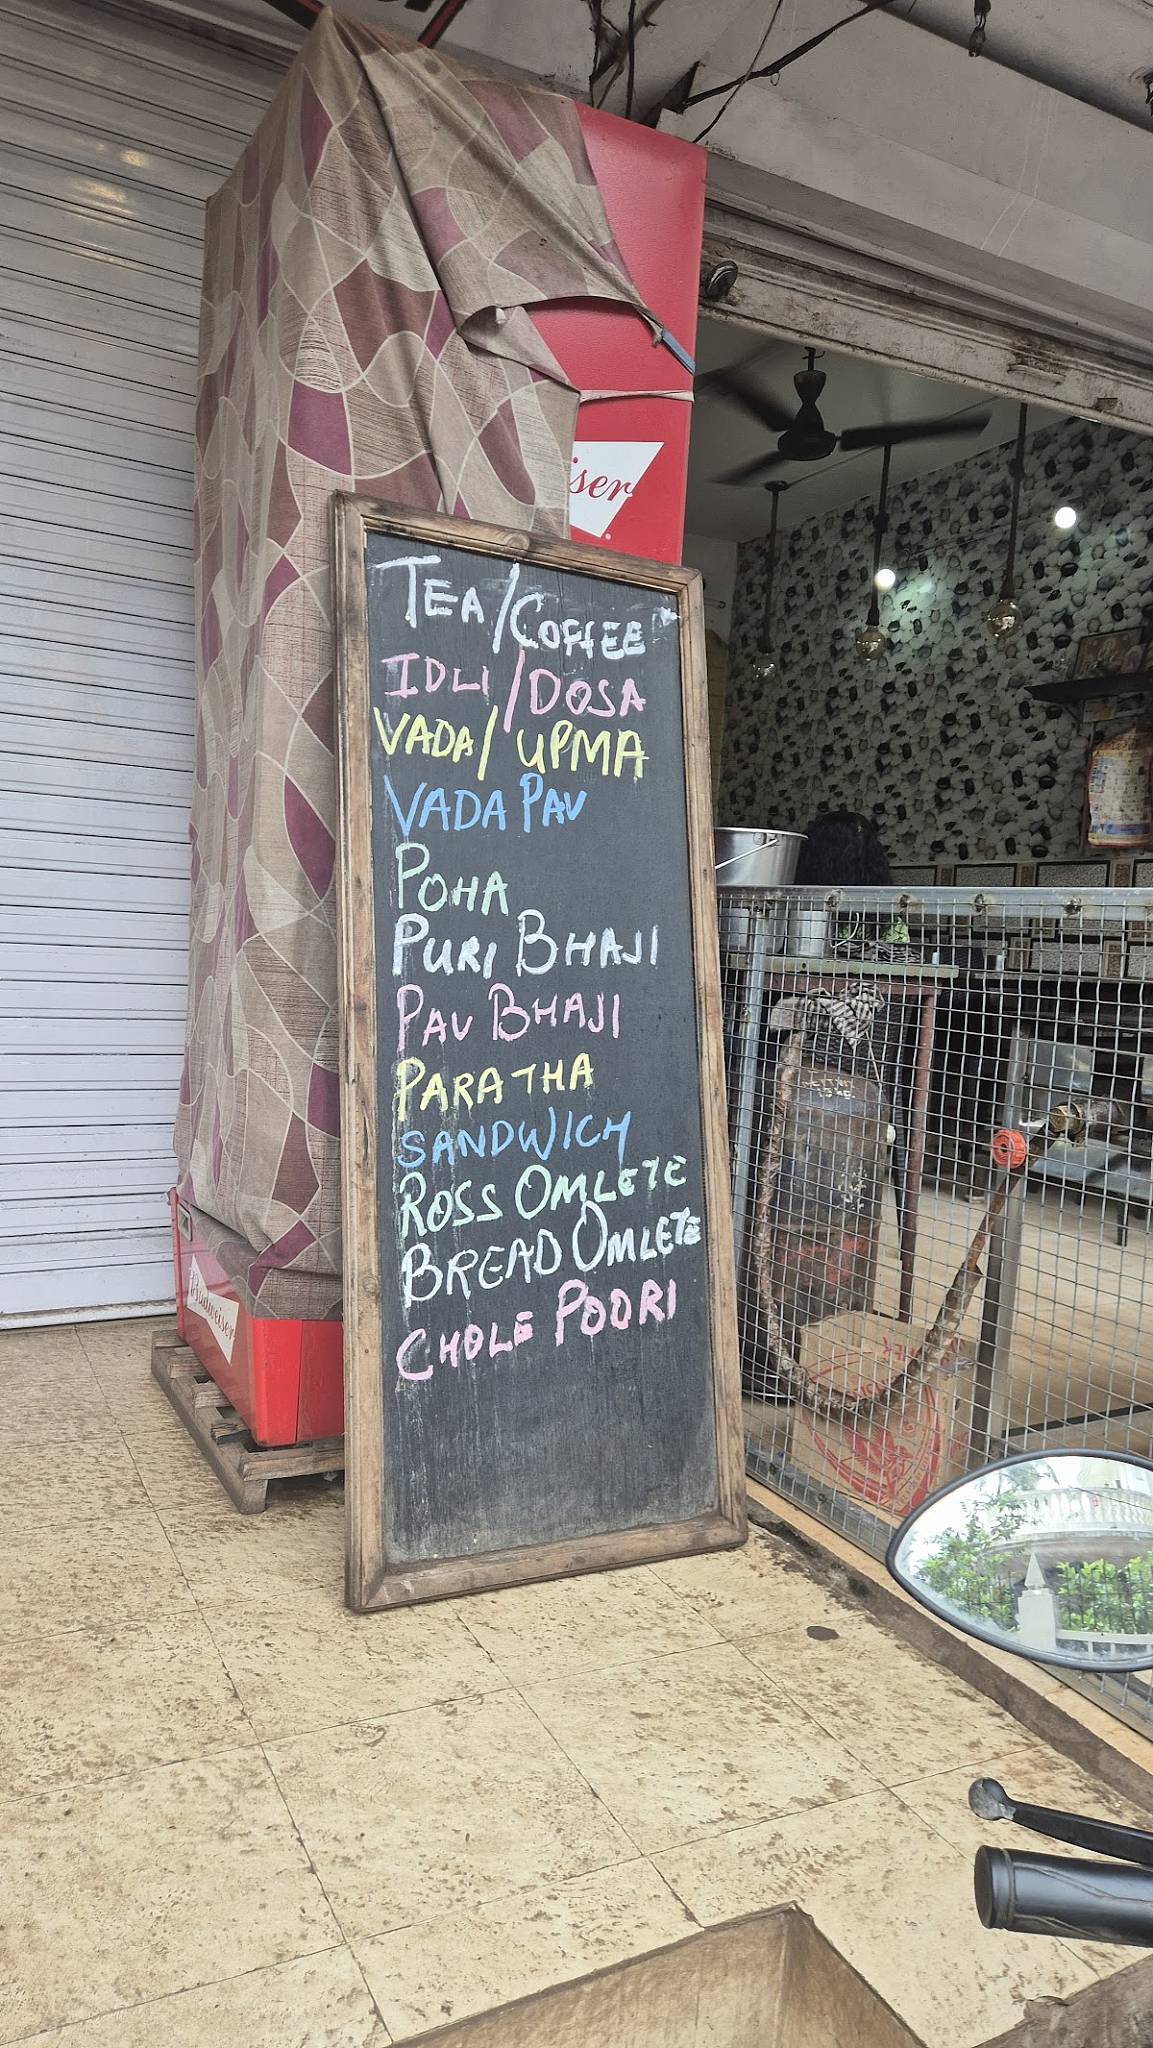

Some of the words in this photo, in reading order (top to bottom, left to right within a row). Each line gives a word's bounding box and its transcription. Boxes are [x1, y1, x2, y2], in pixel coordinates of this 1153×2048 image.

[516, 720, 649, 778] UPMA
[384, 774, 507, 836] VADA
[520, 772, 587, 832] PAV
[395, 842, 509, 915] POHA
[393, 913, 497, 979] PURI
[516, 909, 658, 976] BHAJI
[397, 984, 473, 1051] PAV
[488, 983, 620, 1041] BHAJI
[396, 1053, 595, 1121] PARATHA
[398, 1107, 631, 1168] SANDWICH
[399, 1172, 503, 1237] ROSS
[515, 1156, 687, 1219] OMLETE
[401, 1229, 562, 1307] BREAD
[572, 1201, 701, 1271] OMLETE
[396, 1311, 534, 1380] CHOLE
[556, 1279, 677, 1346] POORI
